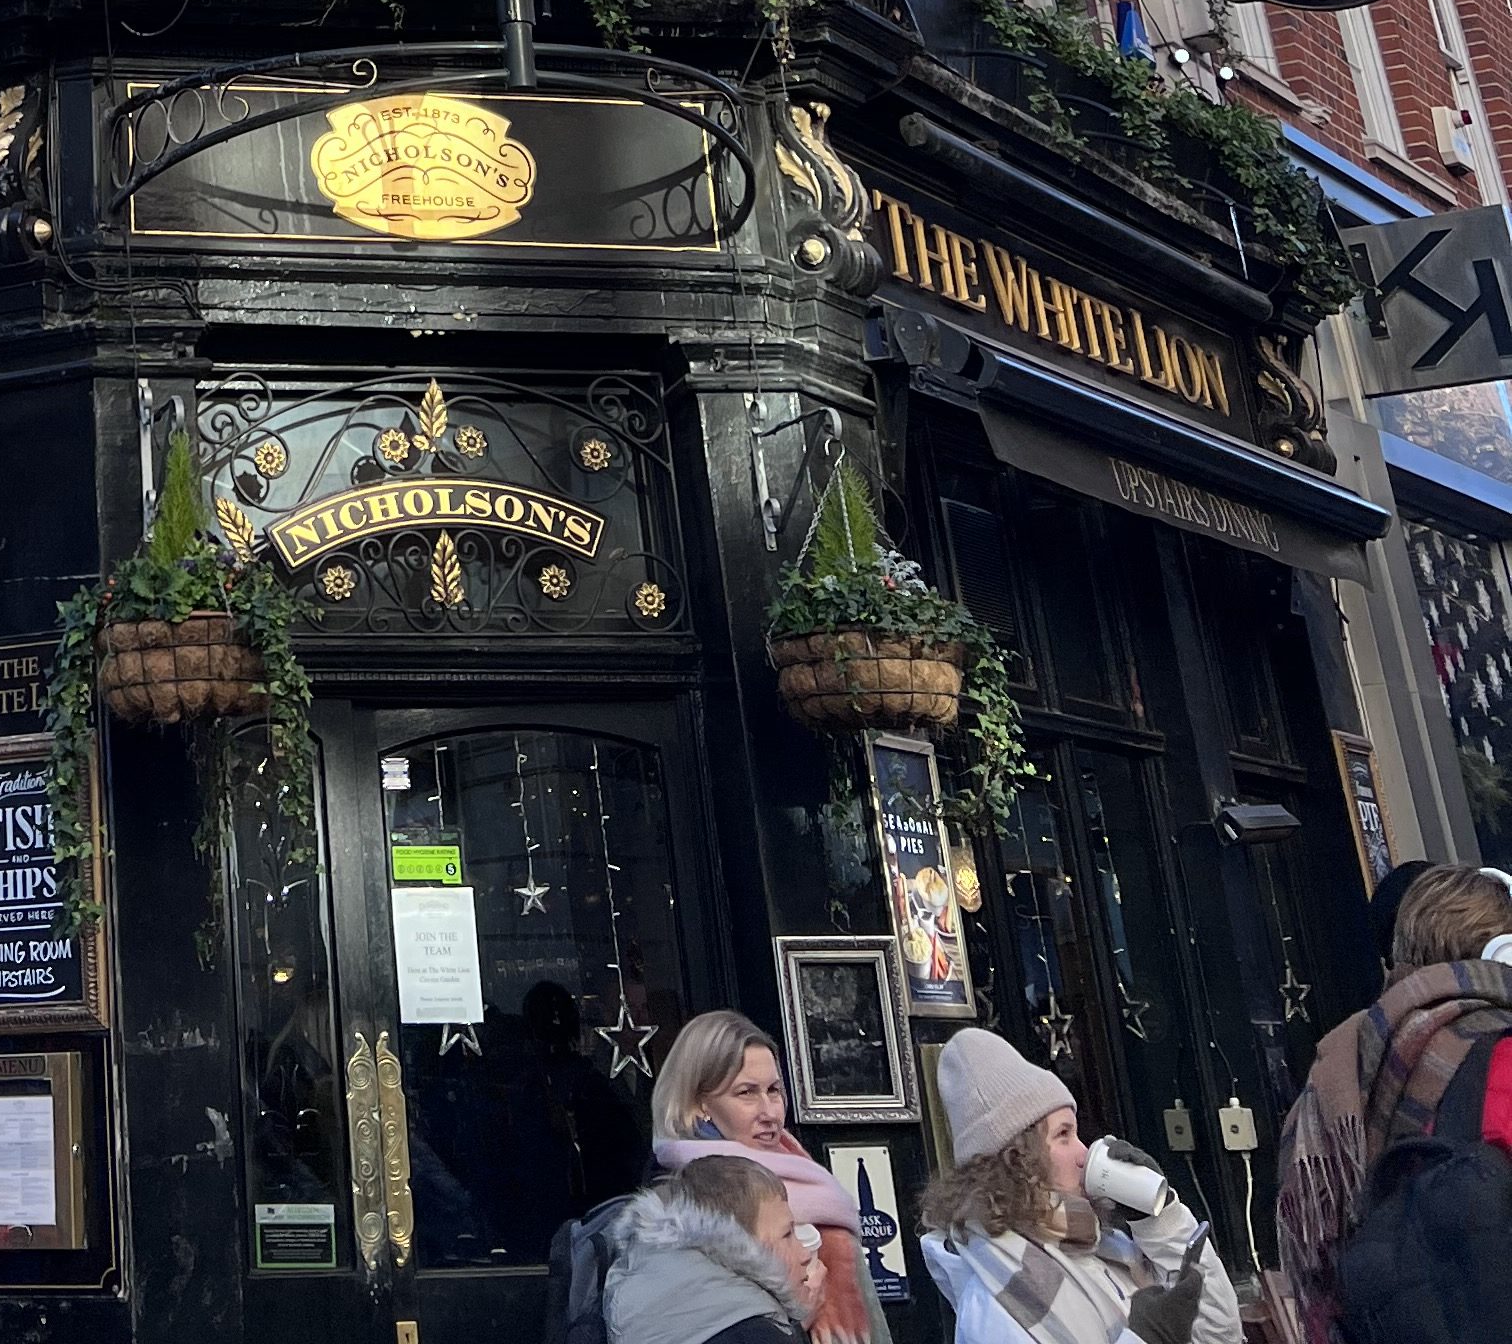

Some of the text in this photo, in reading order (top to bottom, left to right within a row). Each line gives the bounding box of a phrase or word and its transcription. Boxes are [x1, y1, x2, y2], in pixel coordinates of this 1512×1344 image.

[422, 107, 461, 125] 1873
[343, 144, 511, 190] NICHOLSON'S
[381, 193, 476, 209] FREEHOUSE
[872, 189, 1231, 417] THE WHITE LION
[1107, 456, 1280, 553] UPSTAIRS DINING
[284, 487, 593, 556] NICHOLSON'S
[882, 812, 935, 836] SEASONAL
[899, 835, 925, 855] PIES
[11, 854, 30, 864] AND
[27, 909, 55, 922] HERE
[415, 931, 459, 942] JOIN THE
[423, 946, 453, 957] TEAM
[859, 1215, 883, 1226] ASK
